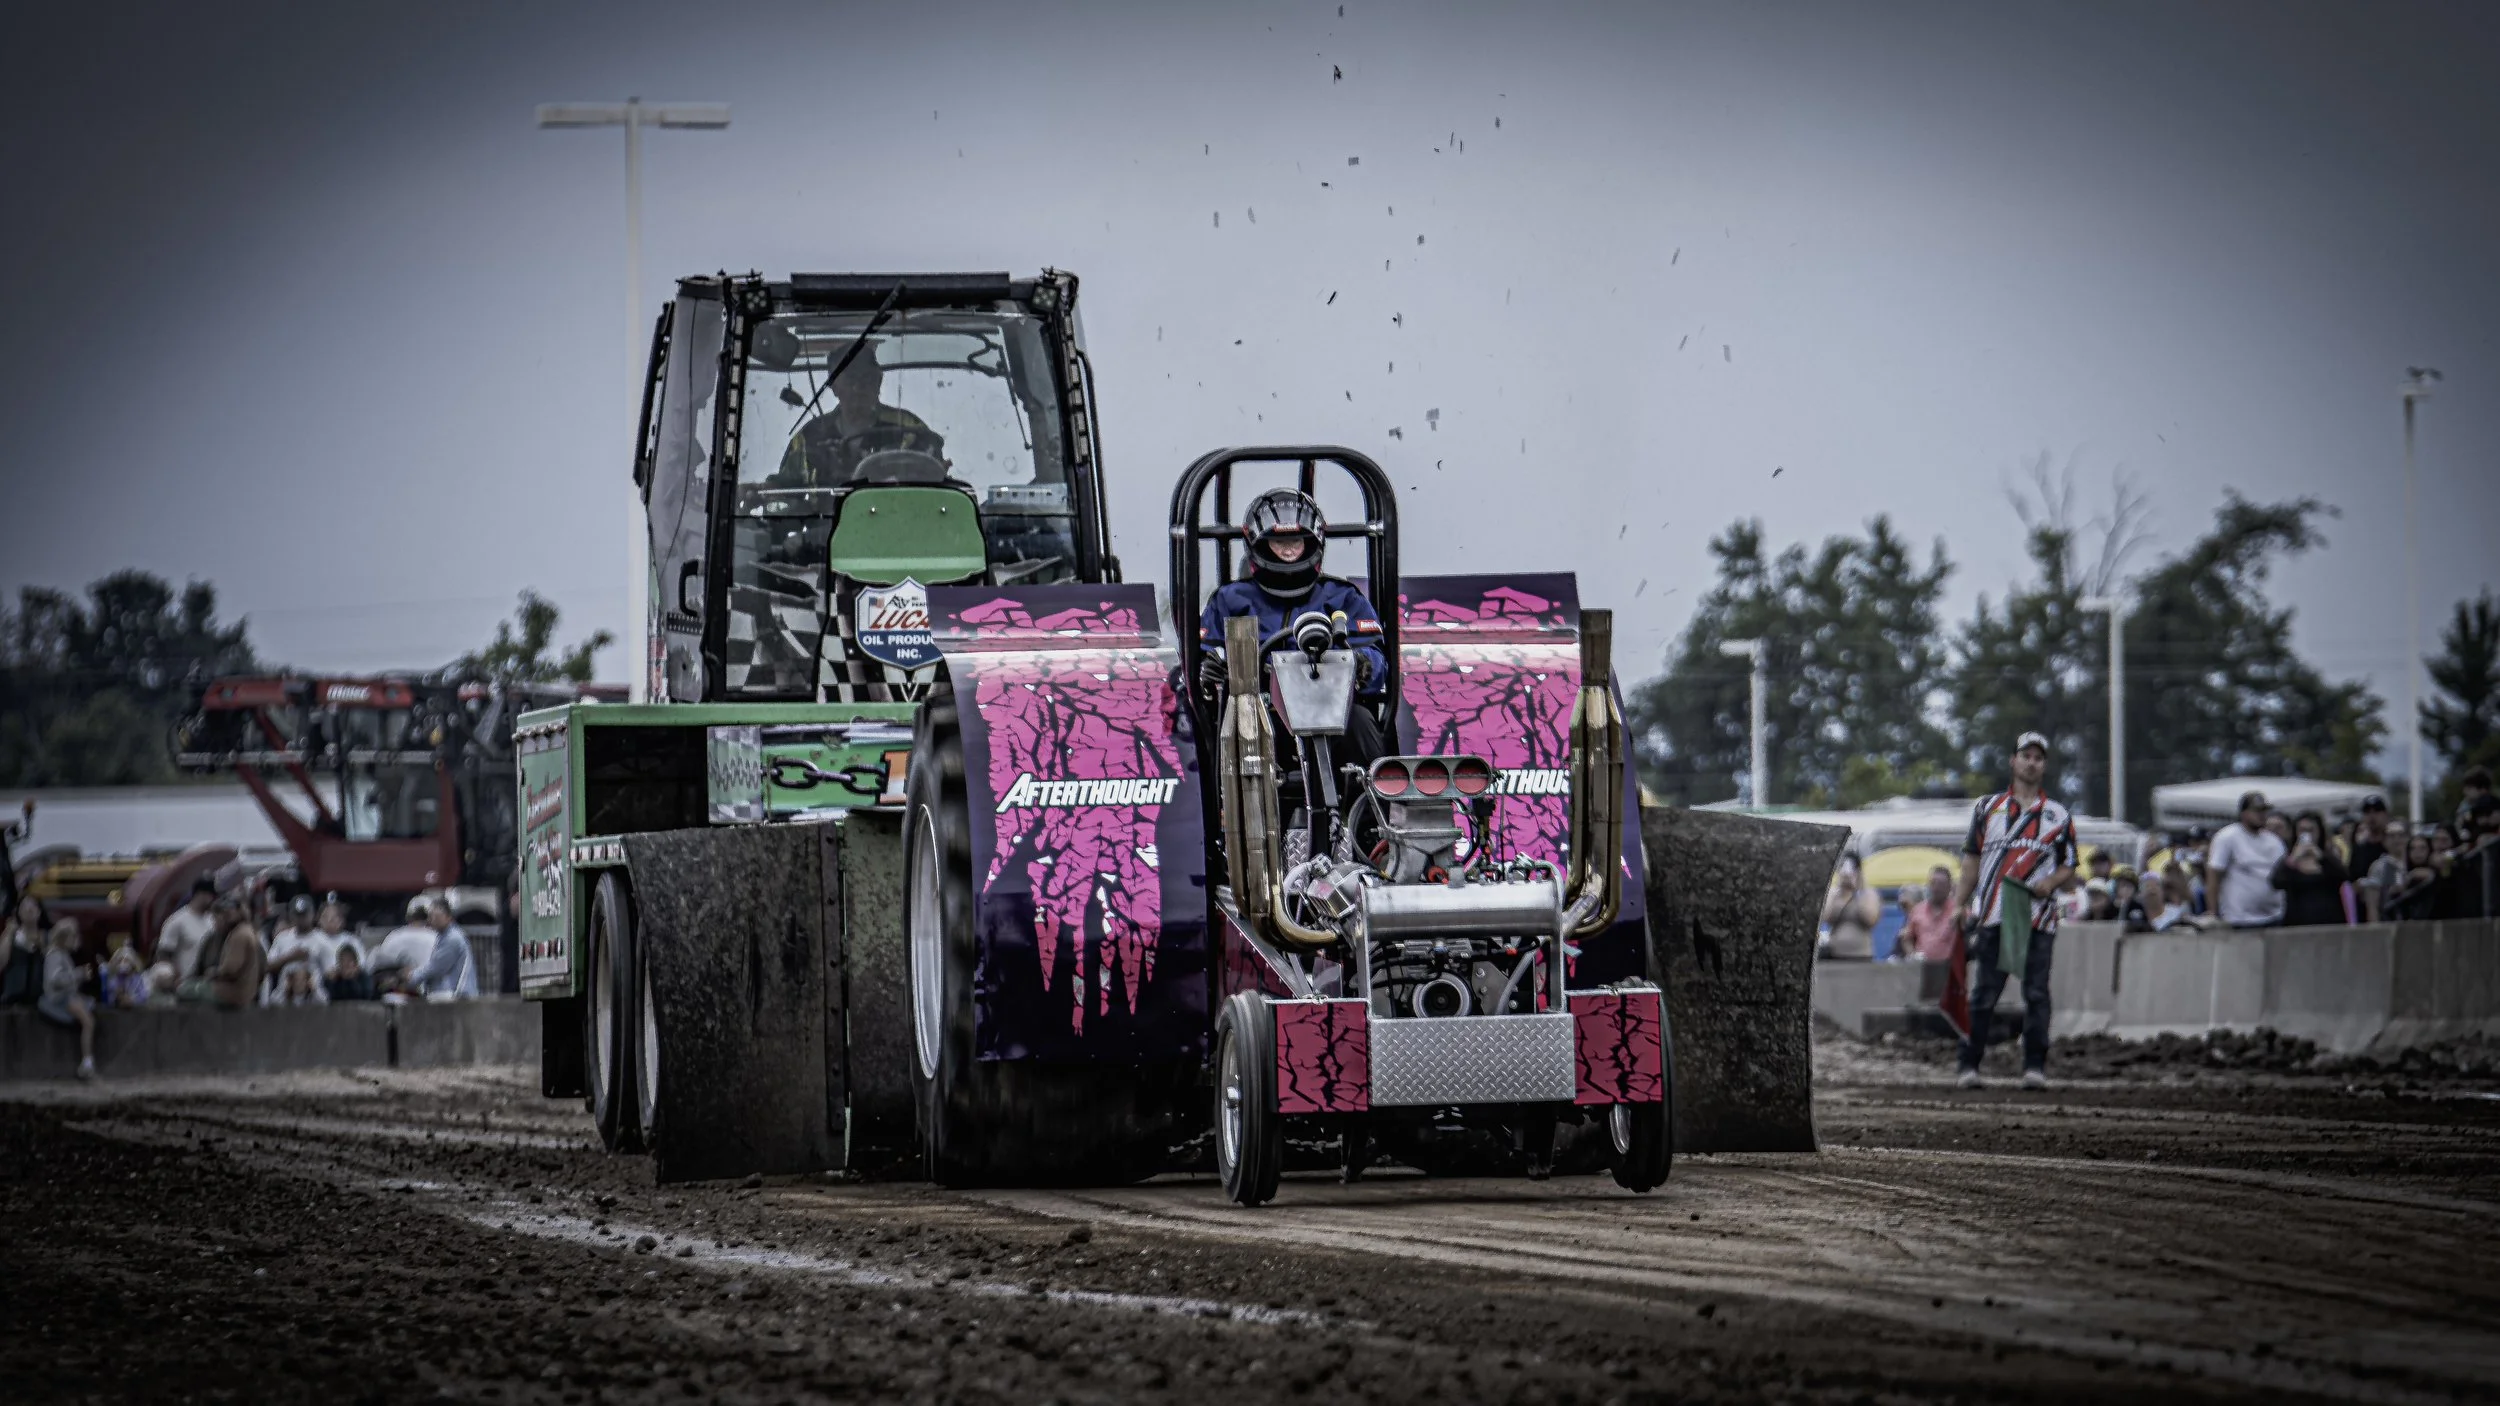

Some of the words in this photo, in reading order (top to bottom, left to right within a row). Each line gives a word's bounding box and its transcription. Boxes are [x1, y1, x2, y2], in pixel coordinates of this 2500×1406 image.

[862, 634, 885, 646] OIL
[887, 634, 935, 646] PRODU
[896, 648, 922, 659] INC.
[995, 772, 1179, 814] AFTERTHOUGHT
